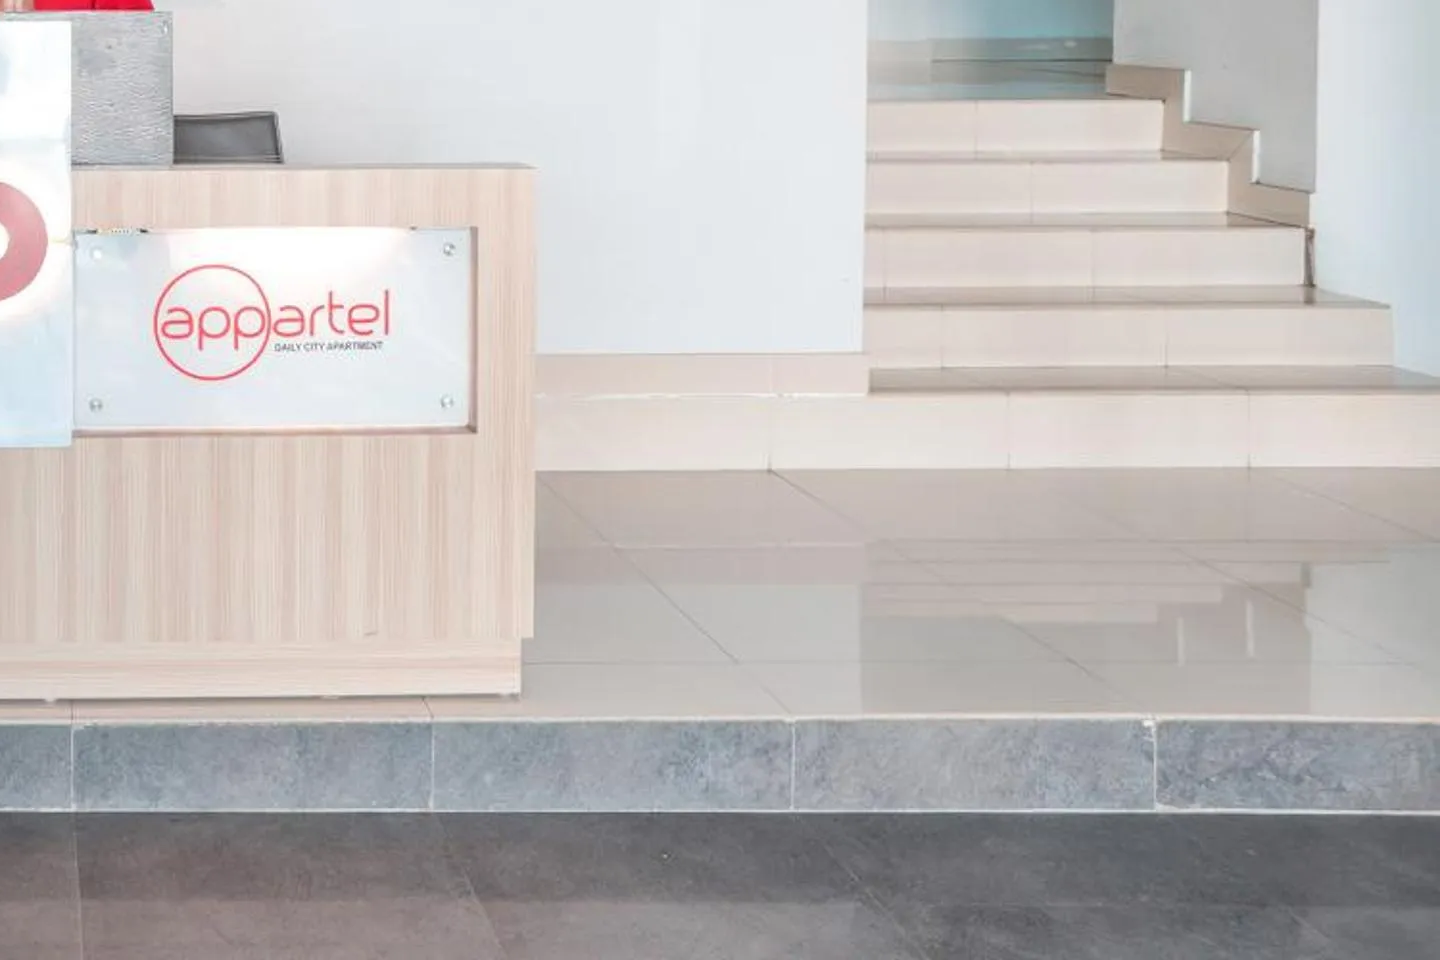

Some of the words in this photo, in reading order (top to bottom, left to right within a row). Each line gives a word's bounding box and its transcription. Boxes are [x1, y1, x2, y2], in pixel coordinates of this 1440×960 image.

[160, 289, 390, 351] appartel
[274, 342, 301, 352] DAILY
[303, 342, 324, 351] CITY
[326, 340, 384, 351] APARTMENT
